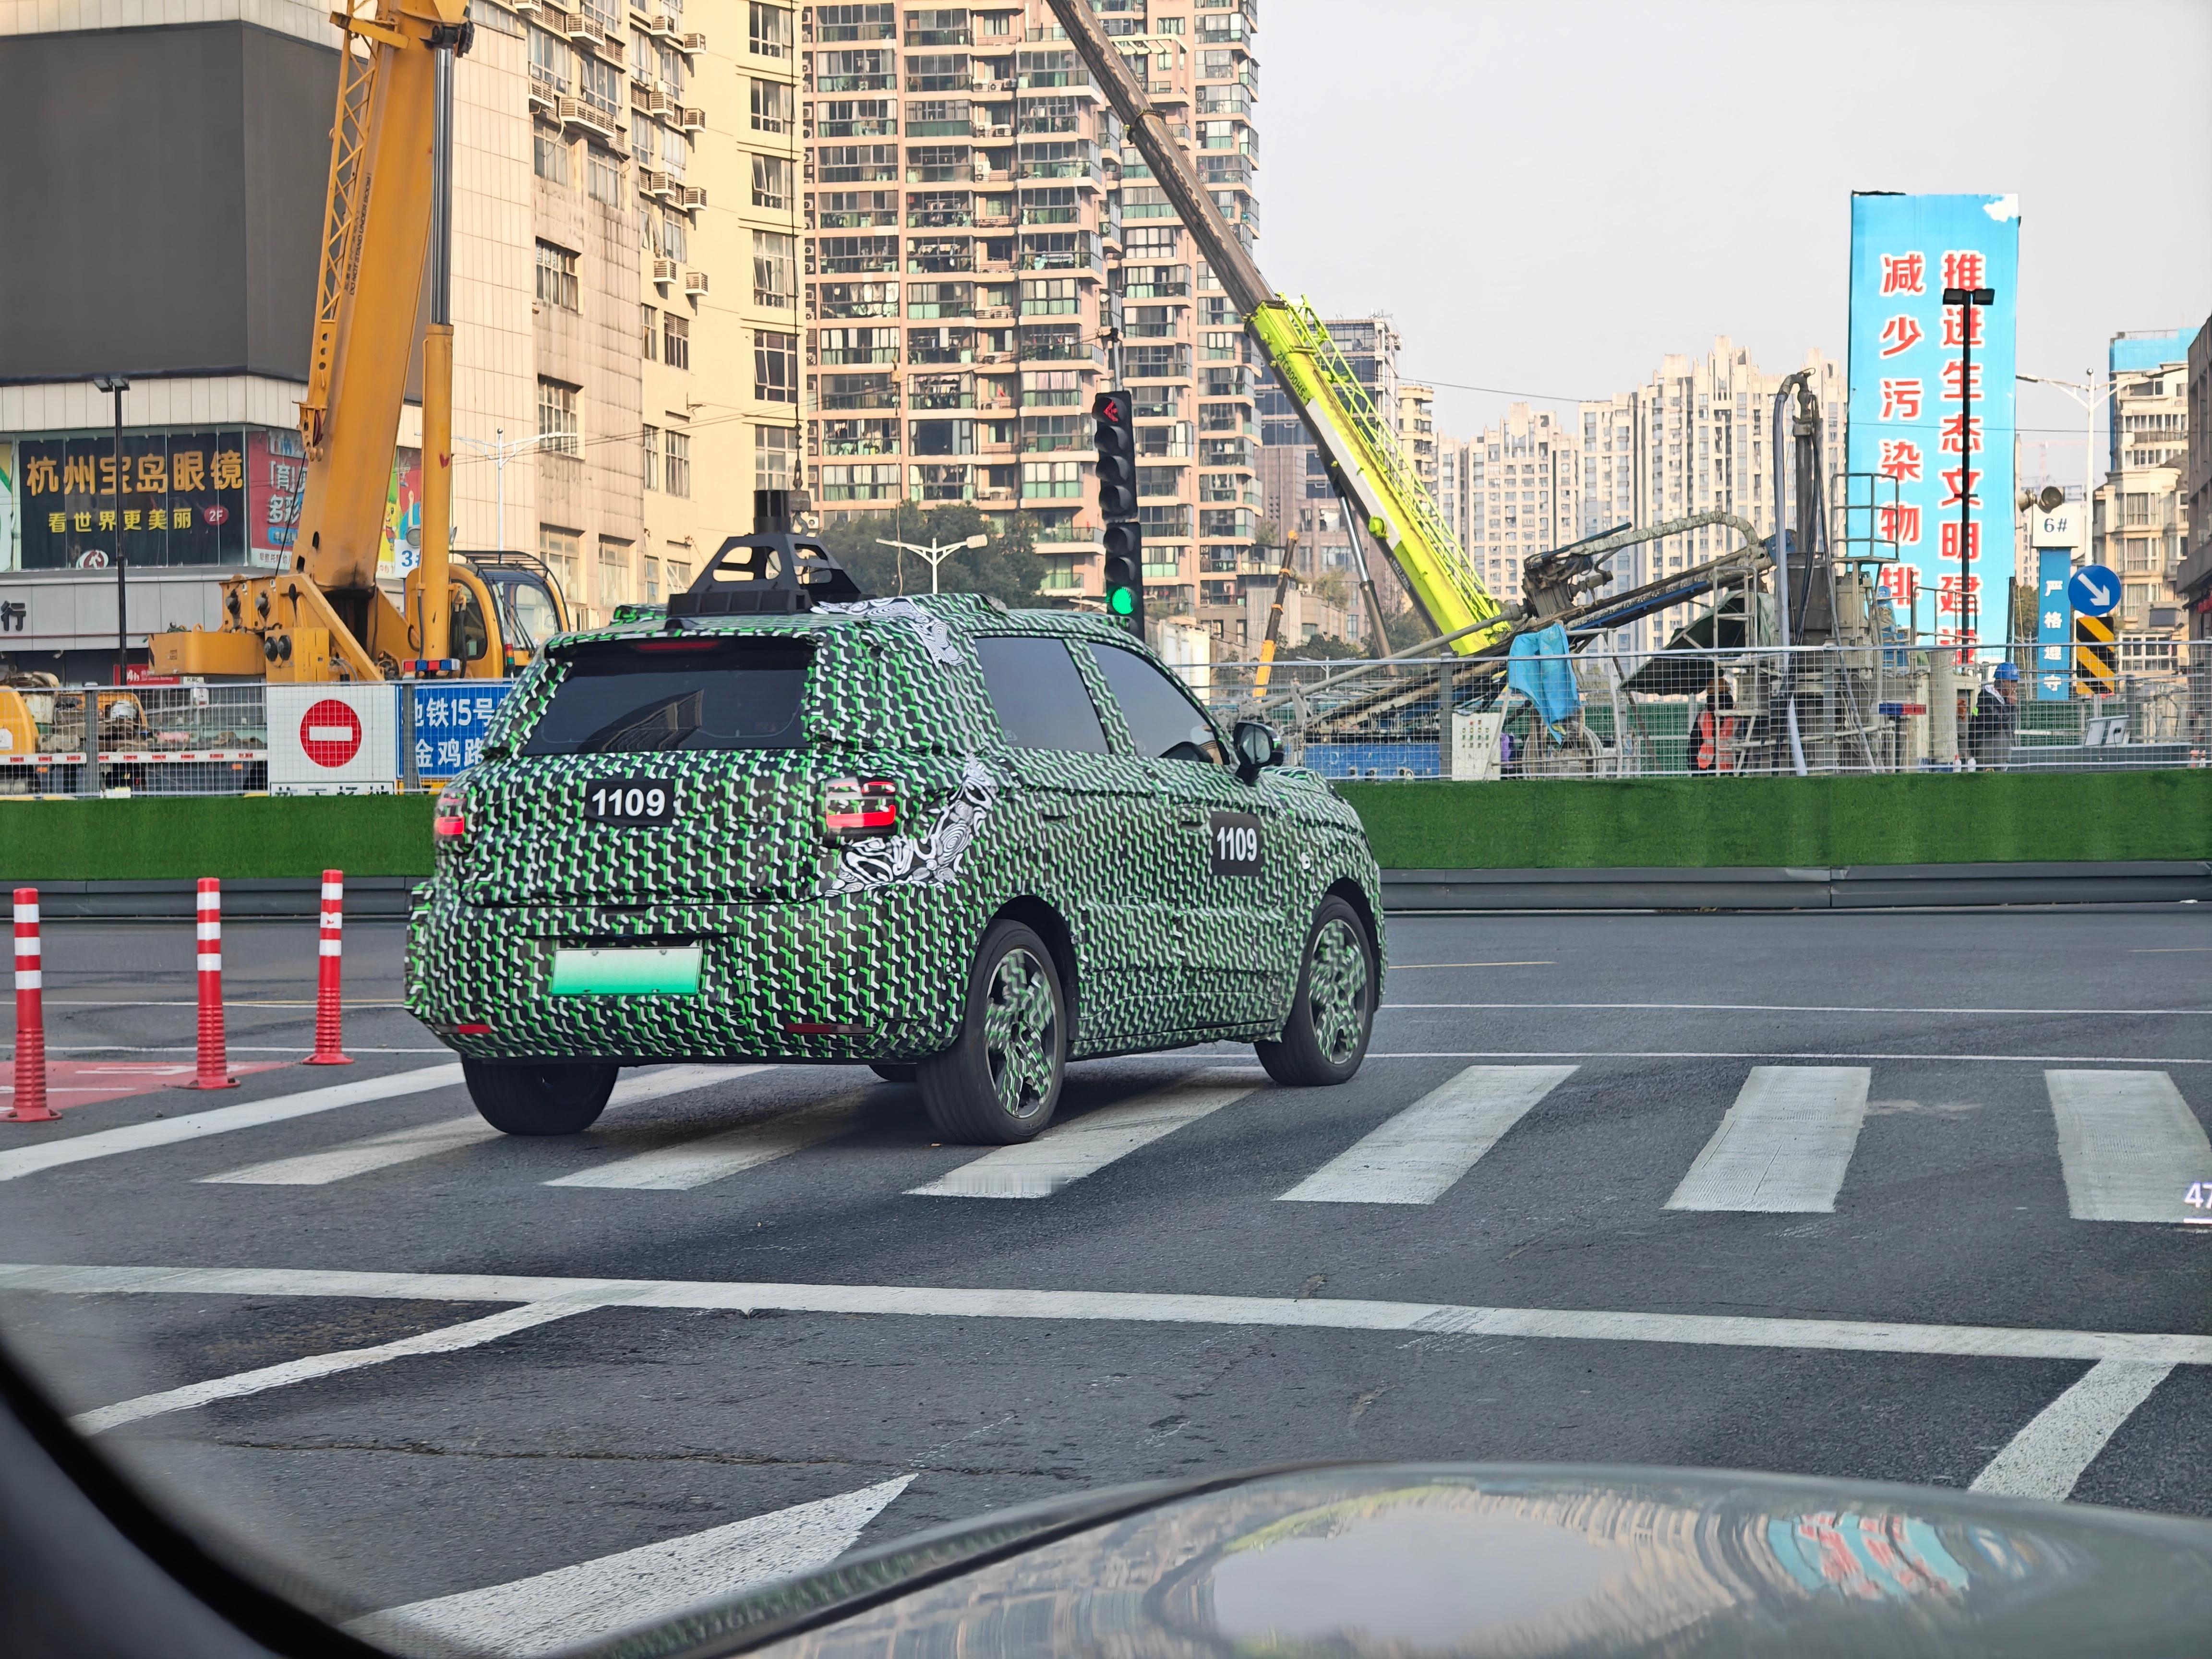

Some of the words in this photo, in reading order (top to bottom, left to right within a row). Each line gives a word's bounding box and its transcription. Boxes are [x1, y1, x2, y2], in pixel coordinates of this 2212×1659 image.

[26, 449, 243, 496] 杭州宝岛眼镜
[48, 507, 192, 533] 看世界更美丽
[209, 510, 223, 522] 2F
[2044, 517, 2068, 532] 6#
[0, 600, 26, 632] 行
[415, 697, 505, 728] 铁15号
[415, 737, 484, 768] 金鸡路
[592, 788, 666, 817] 1109
[1216, 827, 1257, 862] 1109
